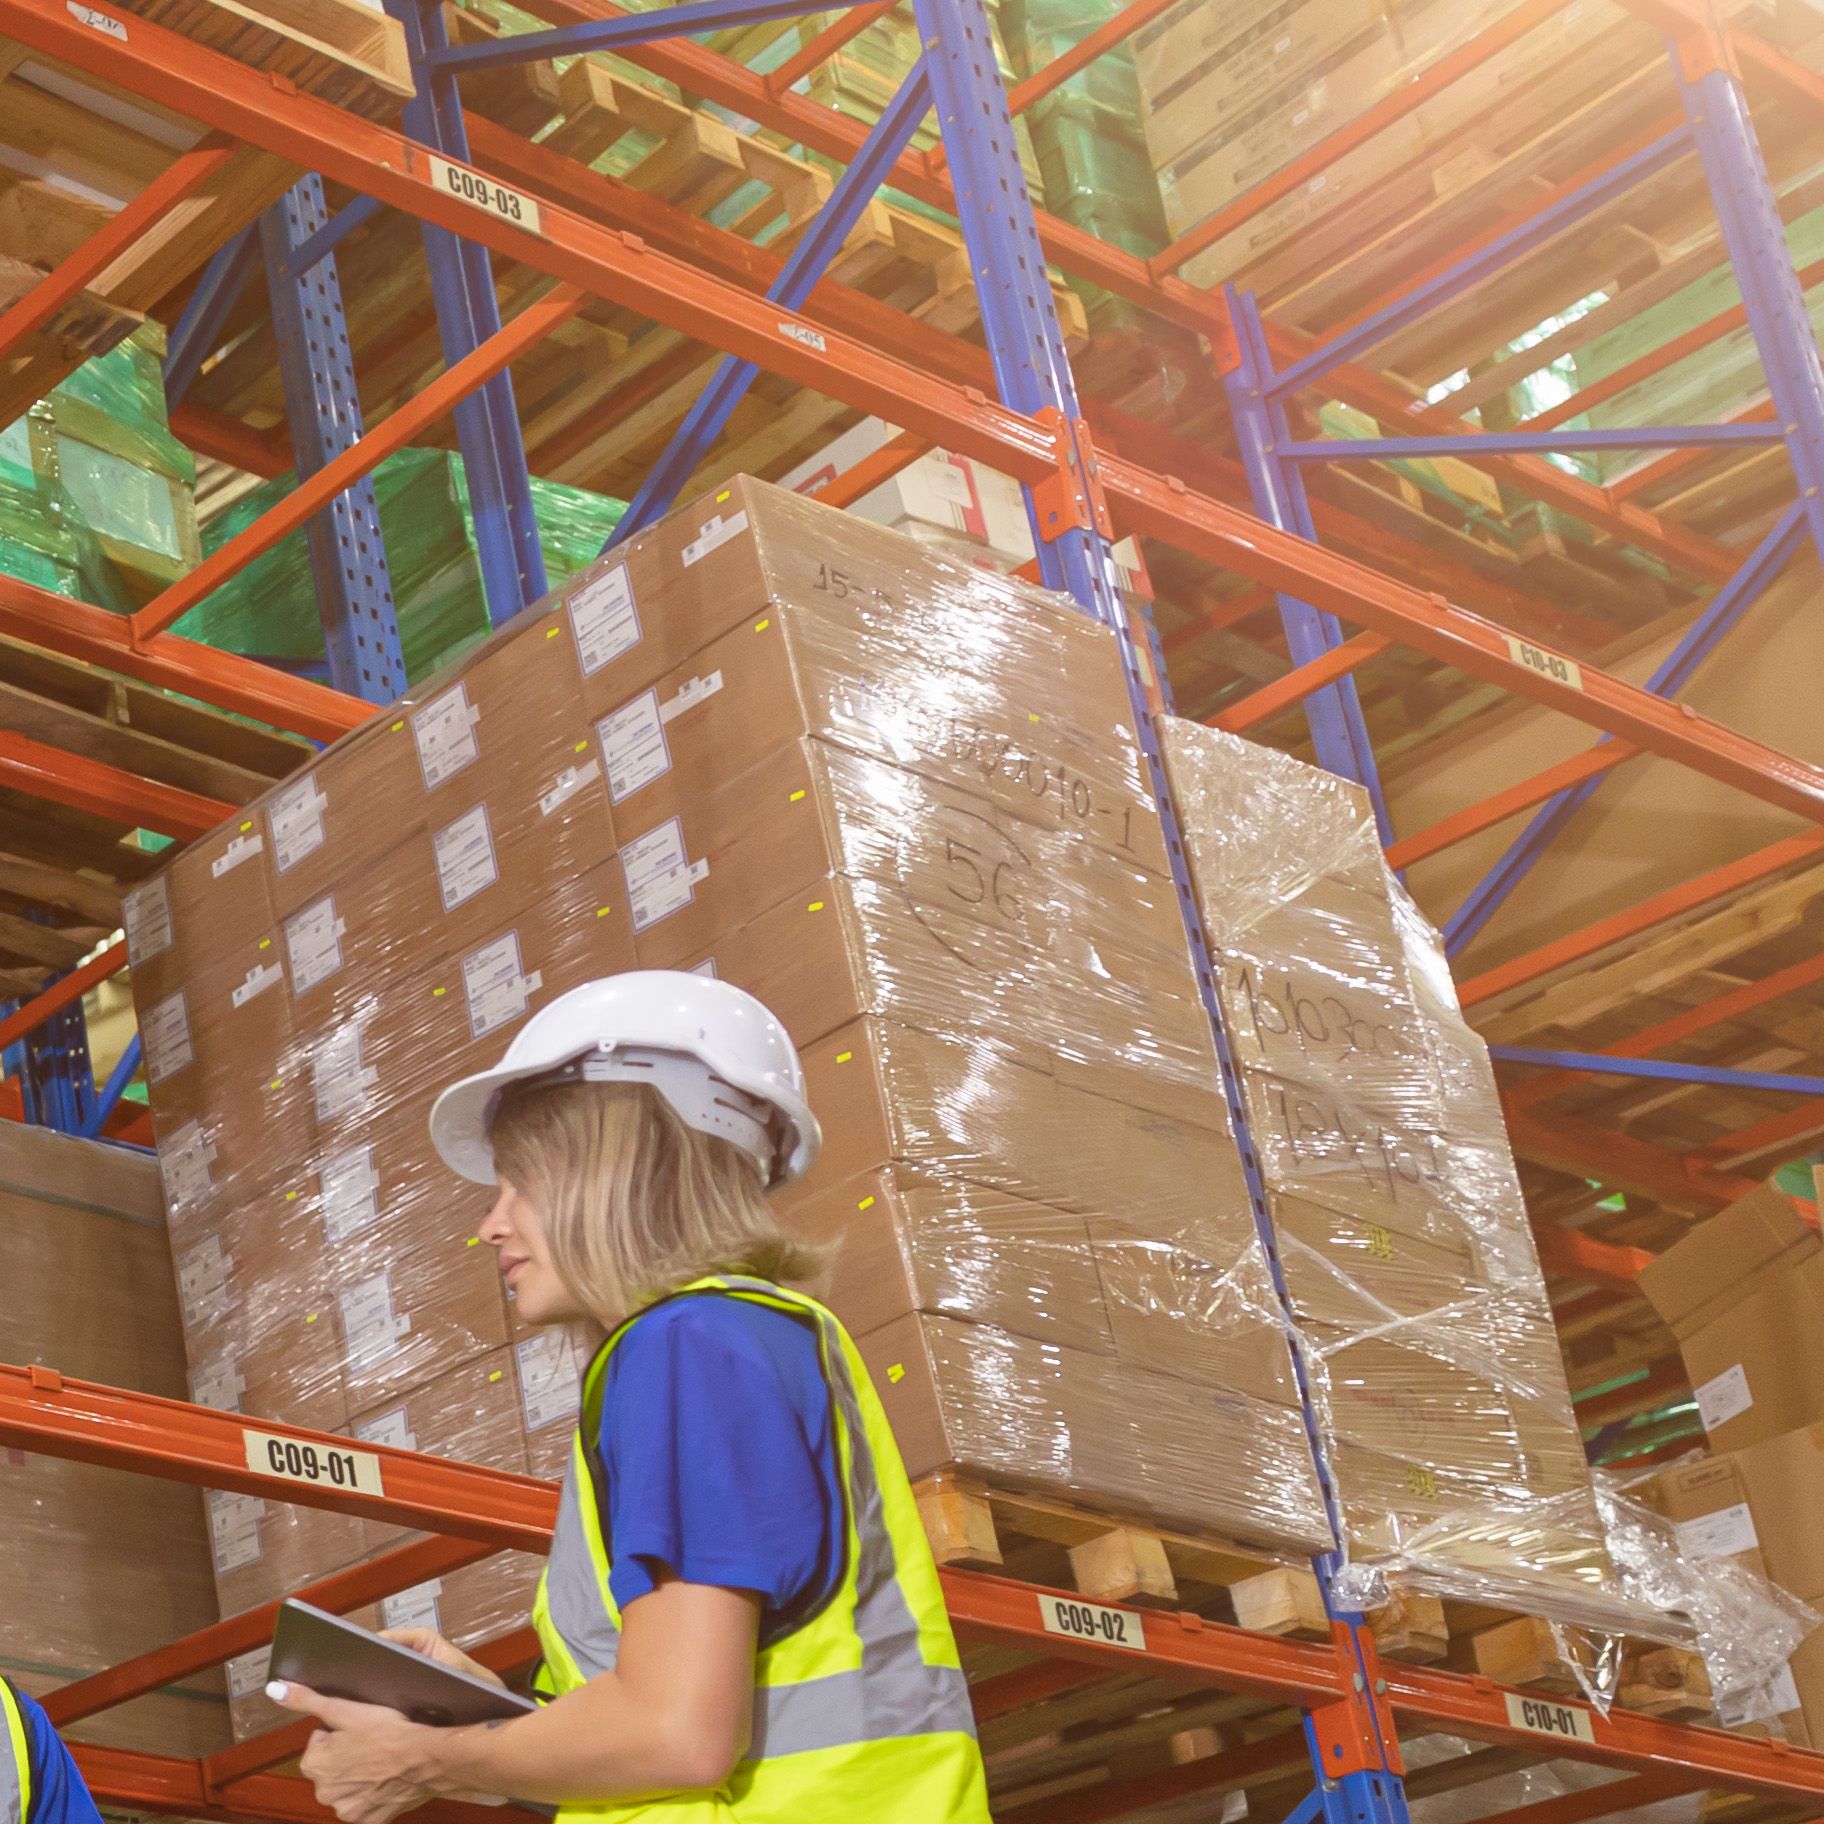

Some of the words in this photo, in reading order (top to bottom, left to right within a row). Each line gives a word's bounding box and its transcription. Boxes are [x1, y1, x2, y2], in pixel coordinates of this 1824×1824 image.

[447, 166, 522, 221] C09-03
[1520, 644, 1568, 682] C10-03
[268, 1439, 359, 1487] C09-01
[1055, 1600, 1128, 1642] C09-02
[1523, 1700, 1578, 1737] C10-01
